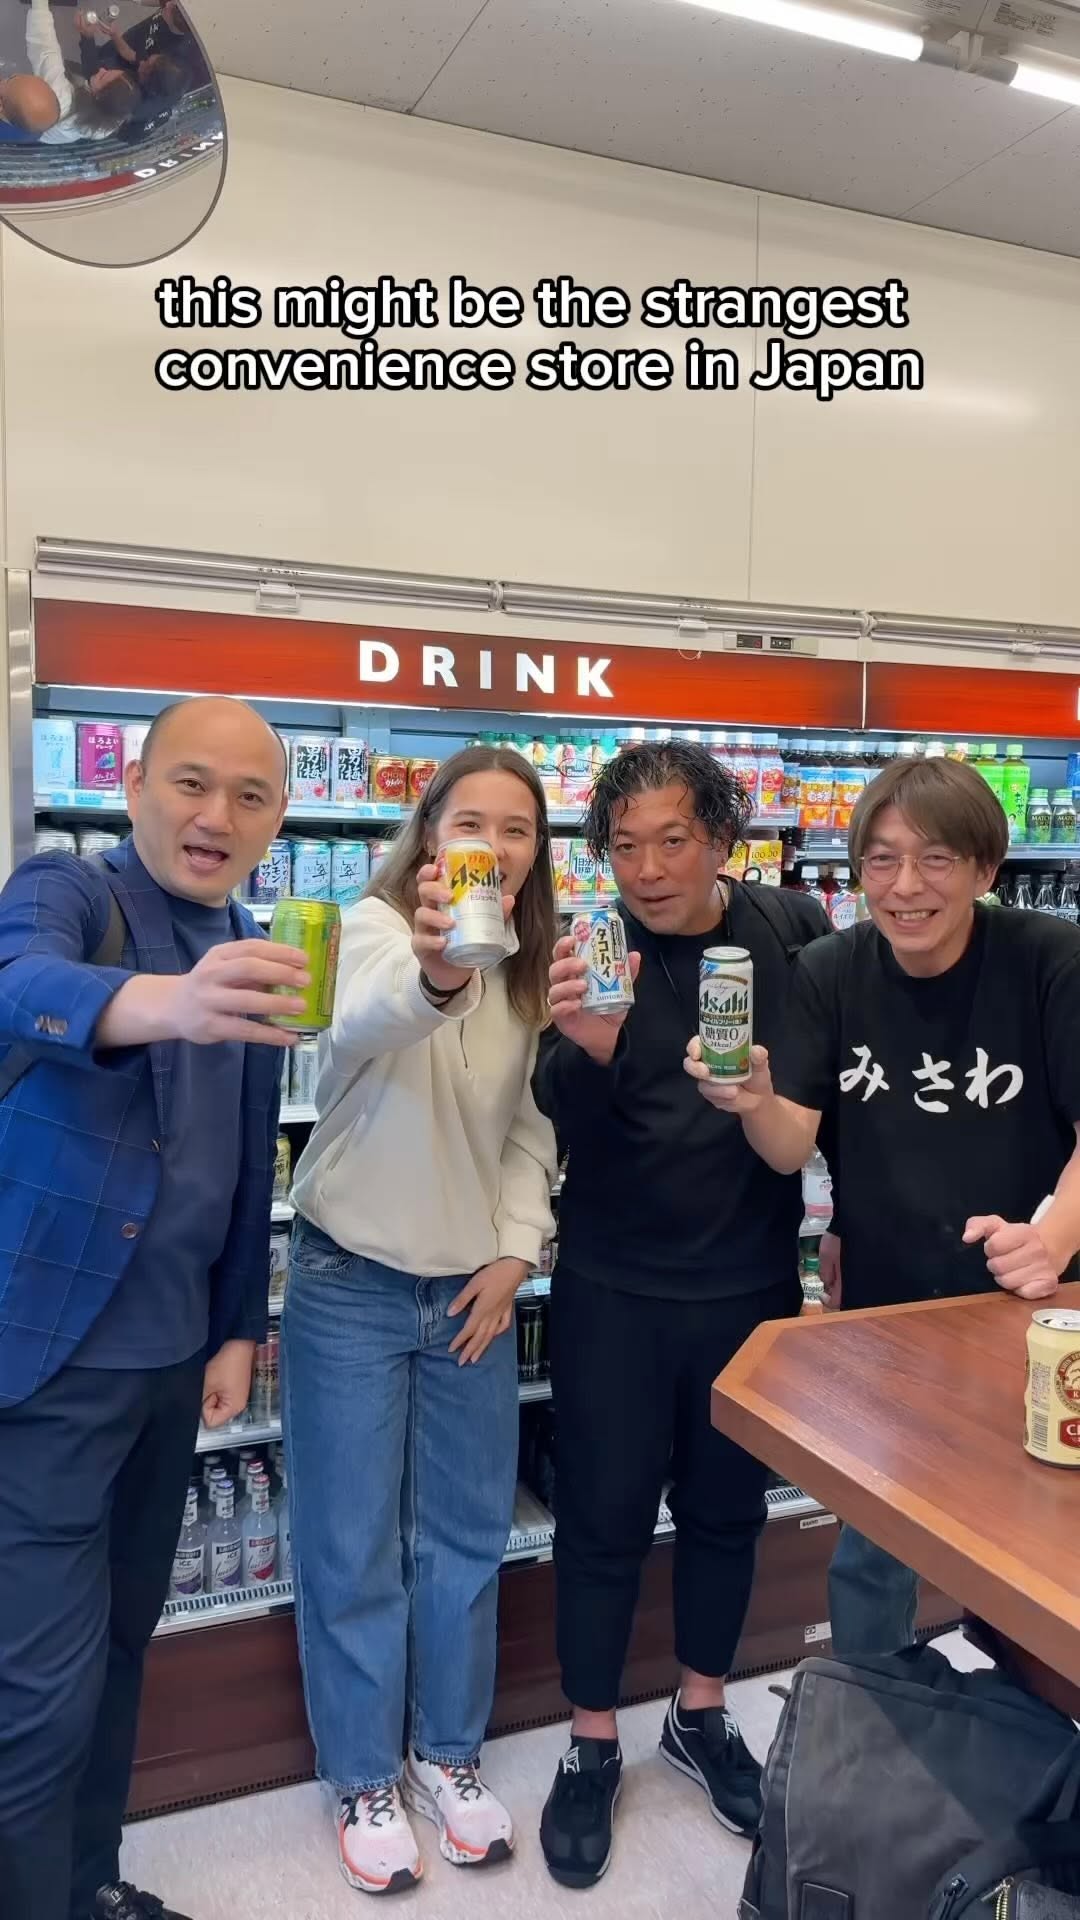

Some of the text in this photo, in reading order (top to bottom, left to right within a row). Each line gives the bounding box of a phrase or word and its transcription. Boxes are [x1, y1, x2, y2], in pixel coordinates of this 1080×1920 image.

[359, 640, 615, 698] DRINK
[88, 736, 119, 745] ほろよい
[304, 745, 322, 780] 男梅
[344, 747, 362, 780] 男梅
[260, 863, 272, 886] サワー
[271, 856, 282, 884] レモン
[596, 927, 612, 978] タコハイ
[700, 989, 749, 1014] Asahi
[705, 1026, 739, 1042] 糖質0
[839, 1044, 1024, 1113] みさわ
